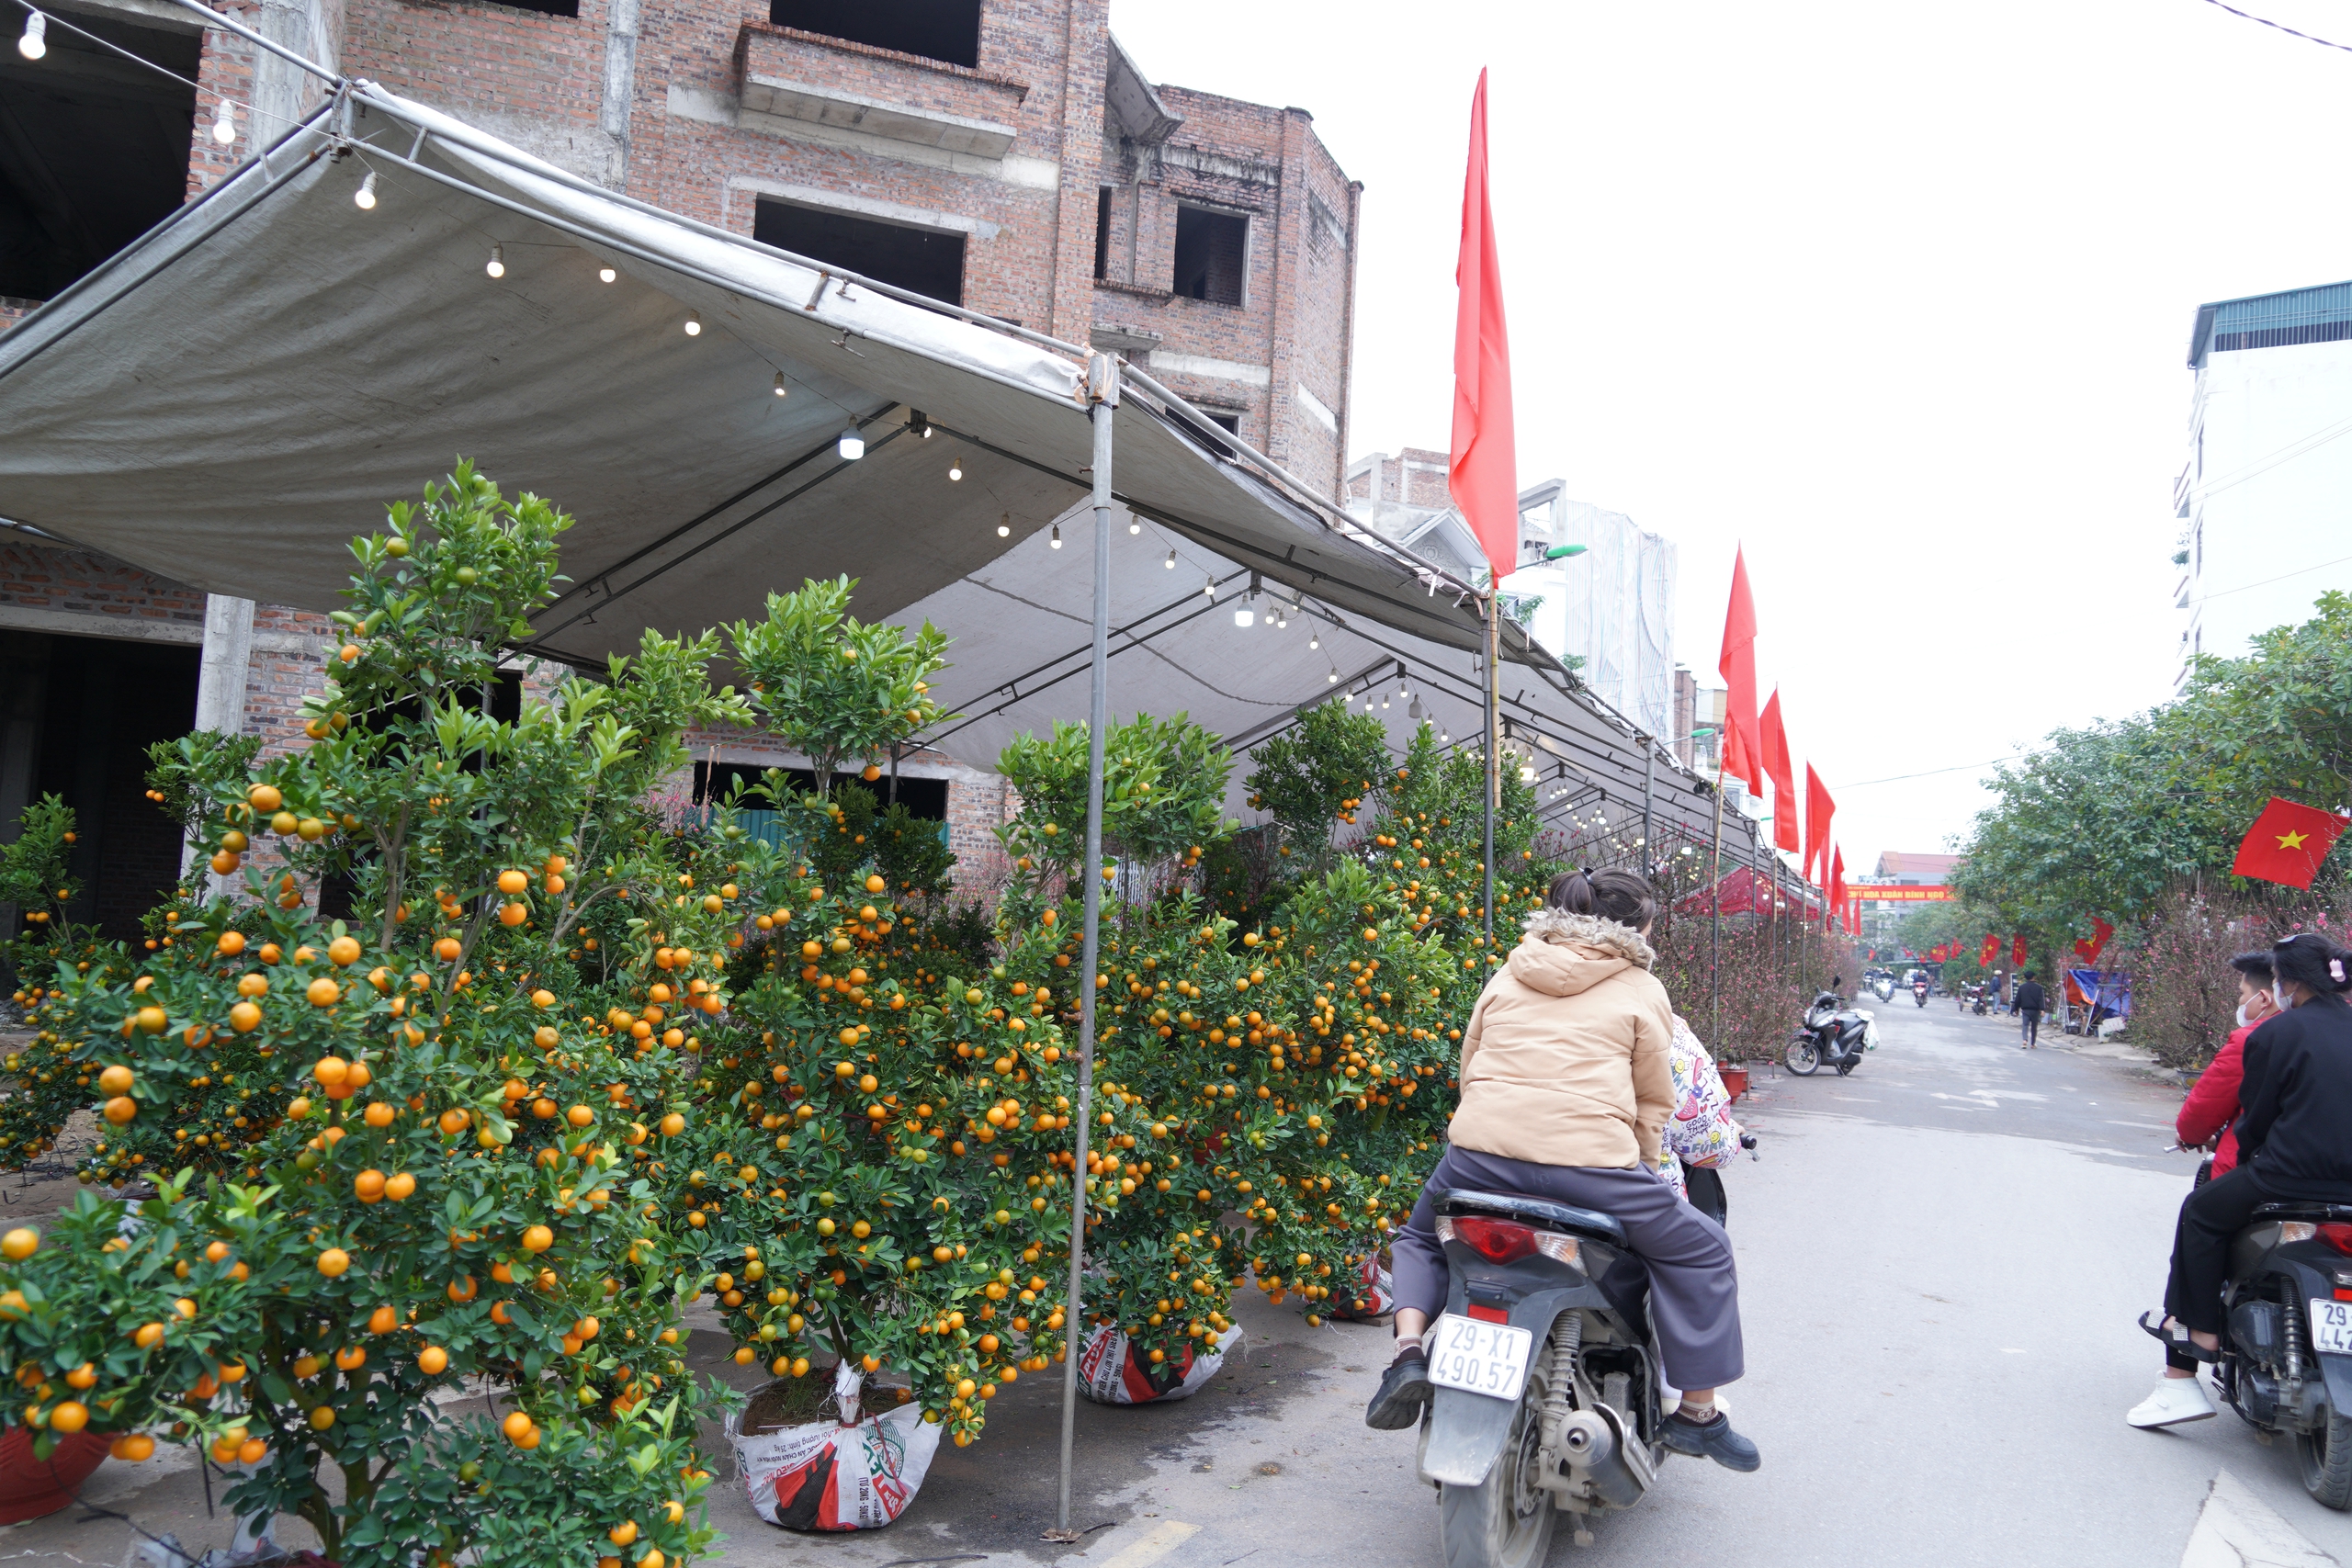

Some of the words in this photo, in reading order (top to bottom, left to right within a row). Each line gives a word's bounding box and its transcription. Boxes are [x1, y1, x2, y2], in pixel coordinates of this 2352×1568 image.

[1882, 890, 1903, 898] XUÂN
[1905, 890, 1925, 898] BÍNH
[1928, 891, 1944, 899] NGỌ
[1686, 1114, 1707, 1129] GOOD
[1691, 1139, 1725, 1155] FUNN
[1450, 1322, 1515, 1360] 29-X1
[1083, 1337, 1103, 1377] PLUS
[1101, 1371, 1111, 1381] CHO
[1437, 1352, 1518, 1393] 490.57
[774, 1444, 780, 1453] kg
[859, 1487, 869, 1501] 20KG
